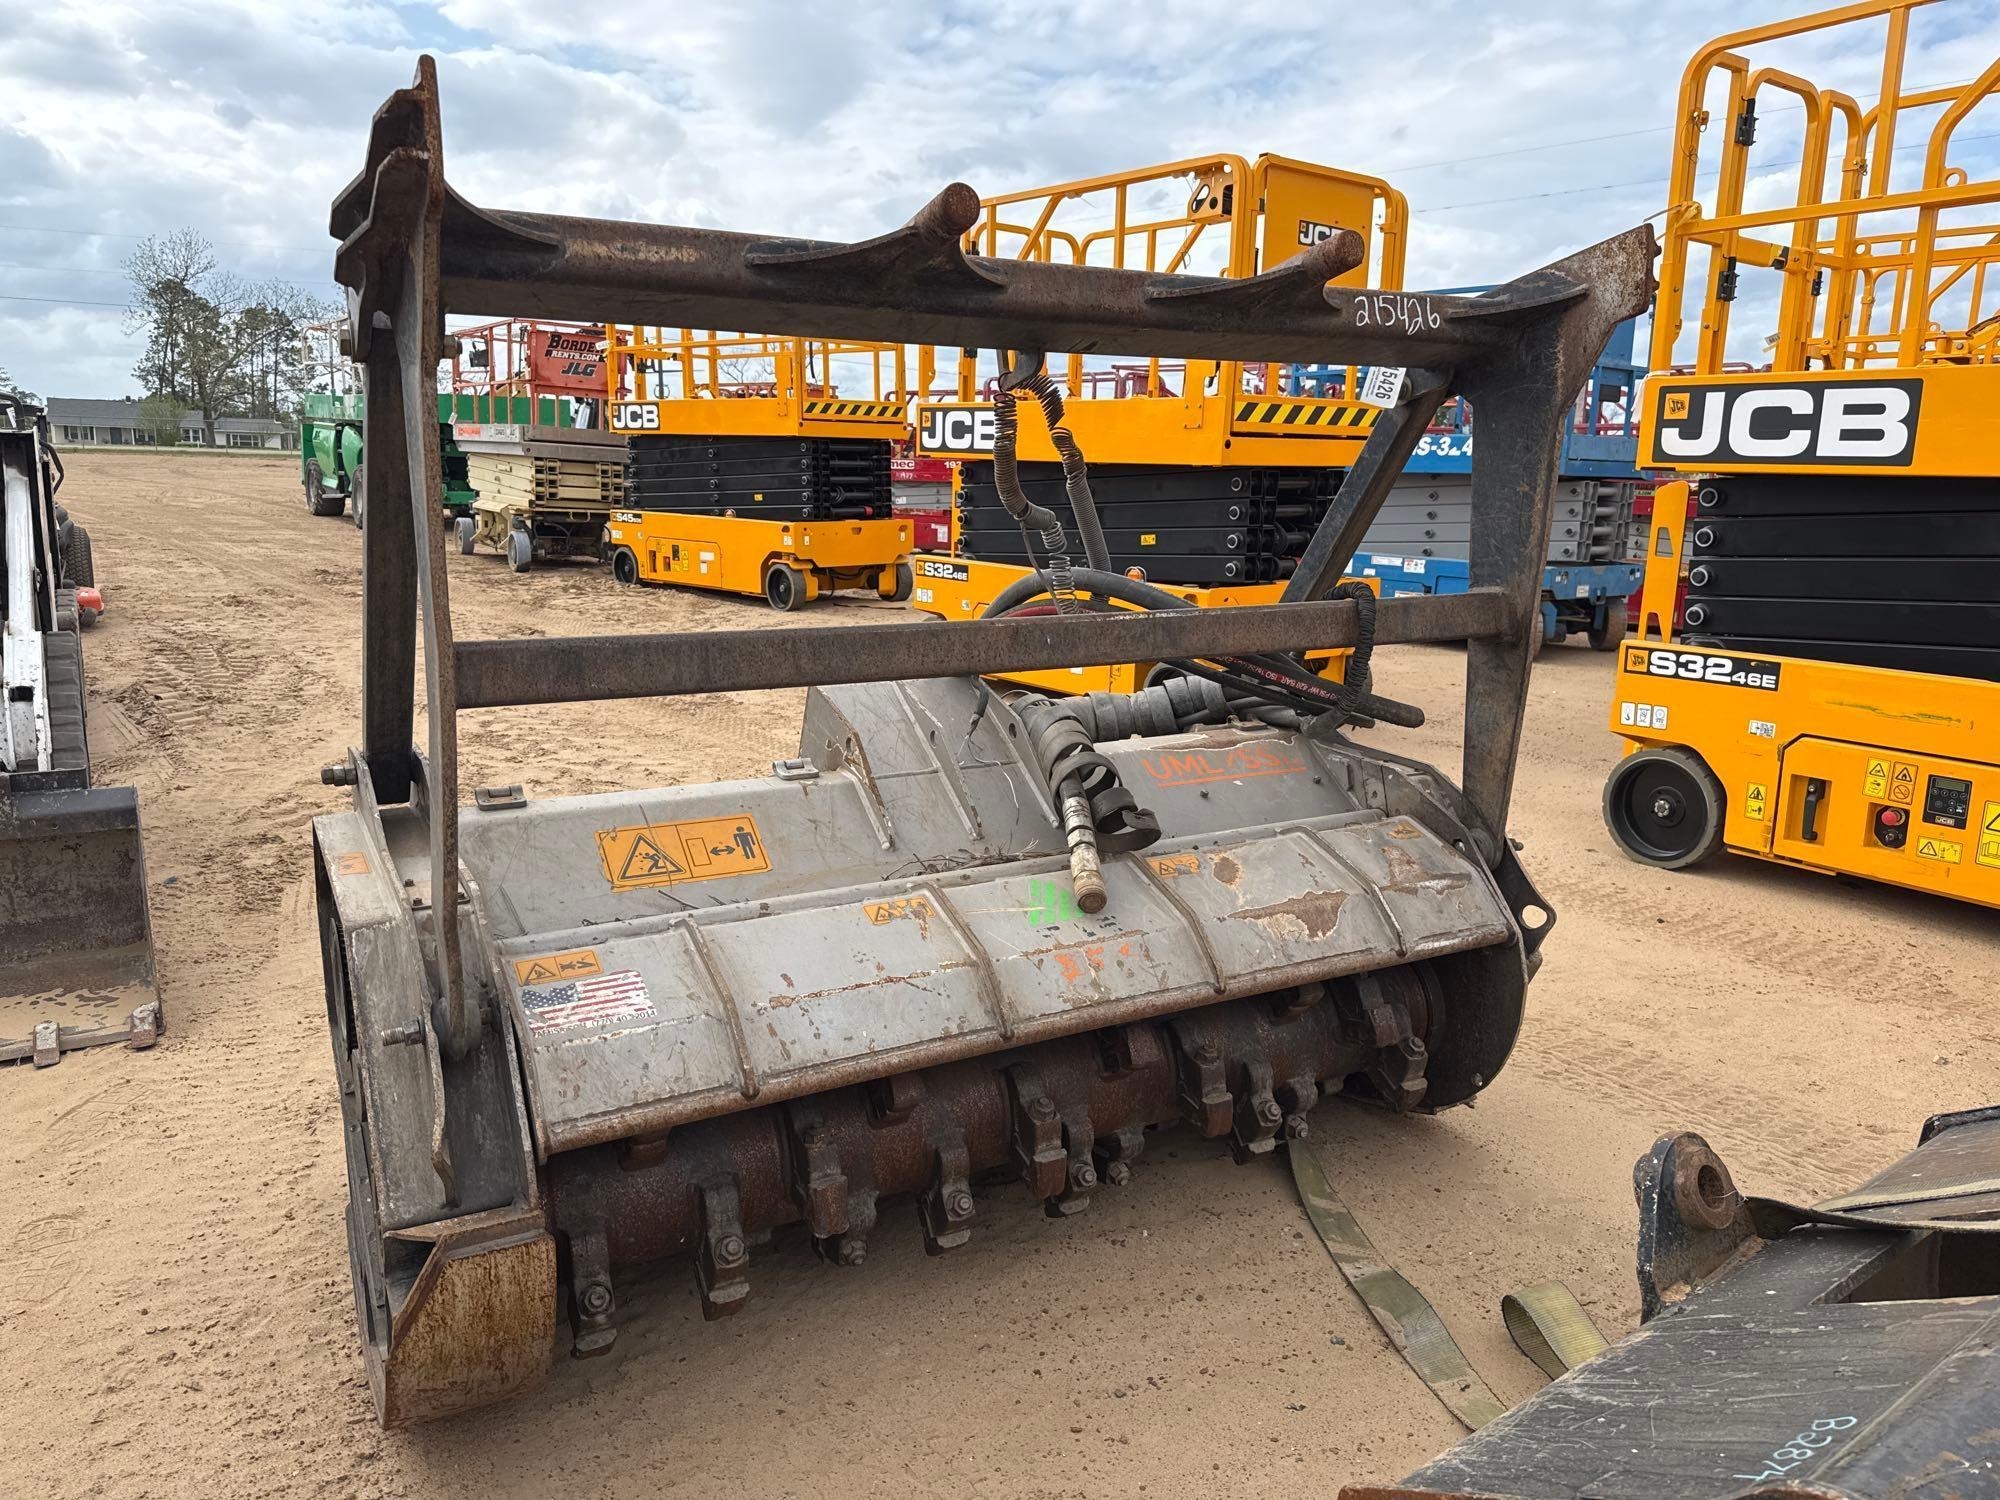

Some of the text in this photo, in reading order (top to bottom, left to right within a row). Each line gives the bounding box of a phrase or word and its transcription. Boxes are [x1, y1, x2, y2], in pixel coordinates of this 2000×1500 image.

[1300, 223, 1345, 245] JC
[1354, 296, 1440, 335] 215426
[561, 362, 597, 377] JLG
[613, 404, 660, 429] JCB
[1660, 387, 1911, 458] JCB
